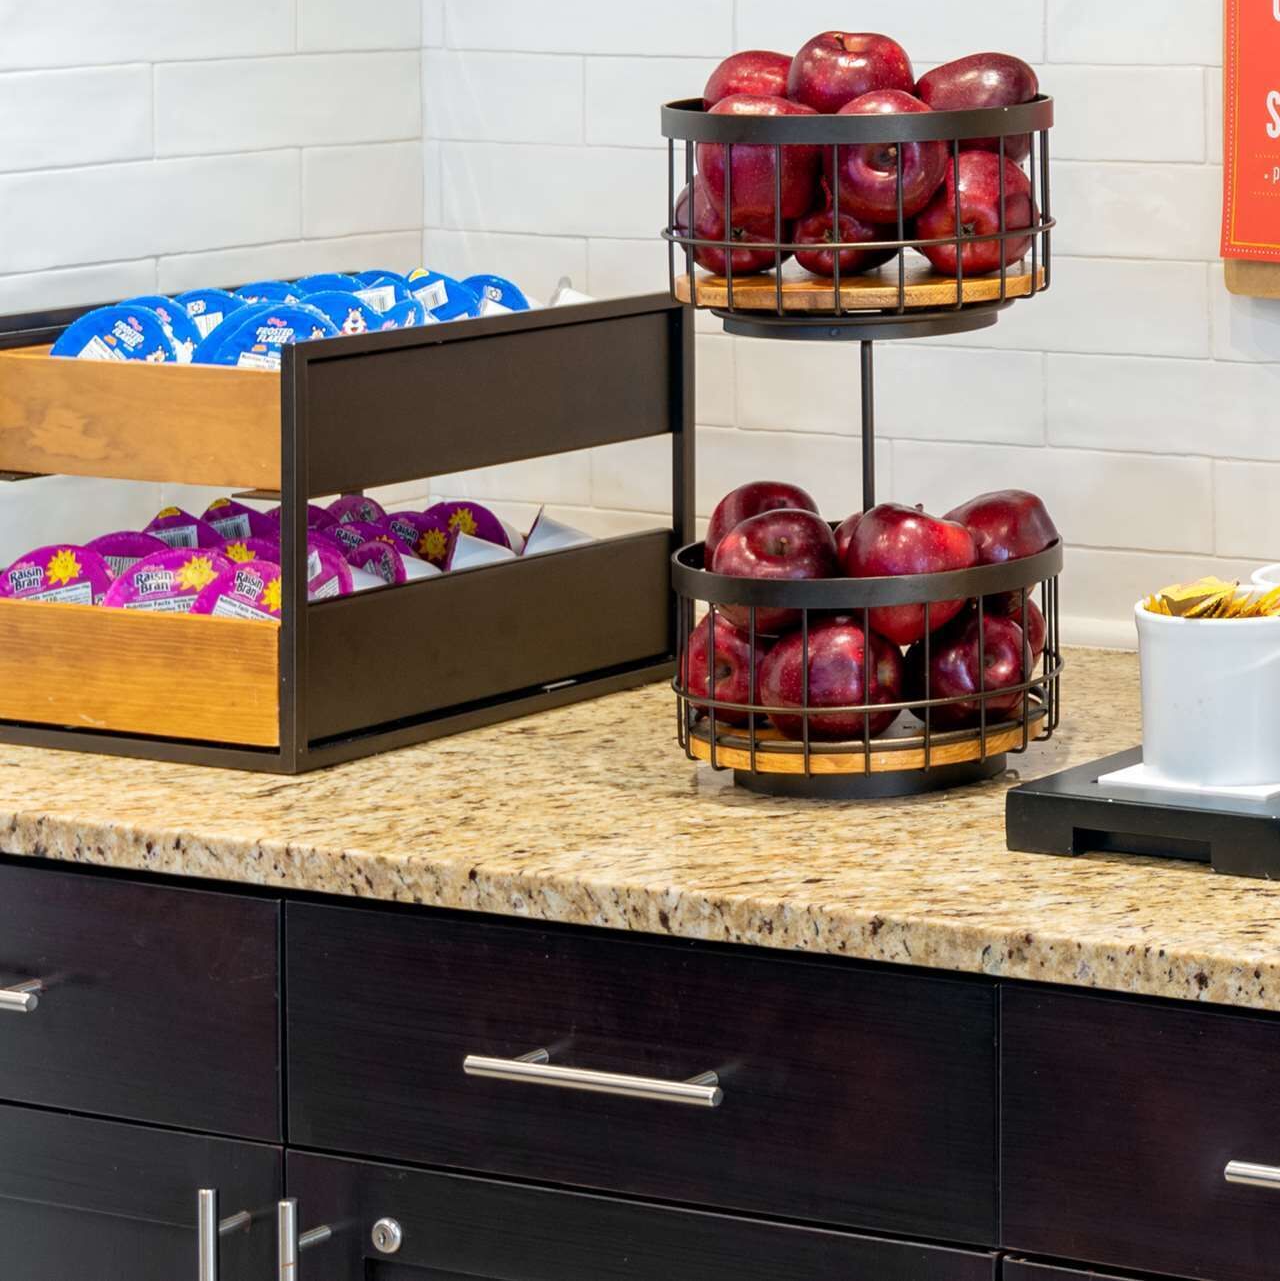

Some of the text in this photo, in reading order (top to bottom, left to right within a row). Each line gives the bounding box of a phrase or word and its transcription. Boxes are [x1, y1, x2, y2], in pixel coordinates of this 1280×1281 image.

[256, 327, 294, 336] FROSTED
[9, 566, 42, 583] Raisin
[135, 570, 172, 586] Raisin
[236, 571, 264, 591] Raisin
[14, 578, 39, 592] Bran
[140, 581, 168, 595] Bran
[236, 582, 257, 599] Bran
